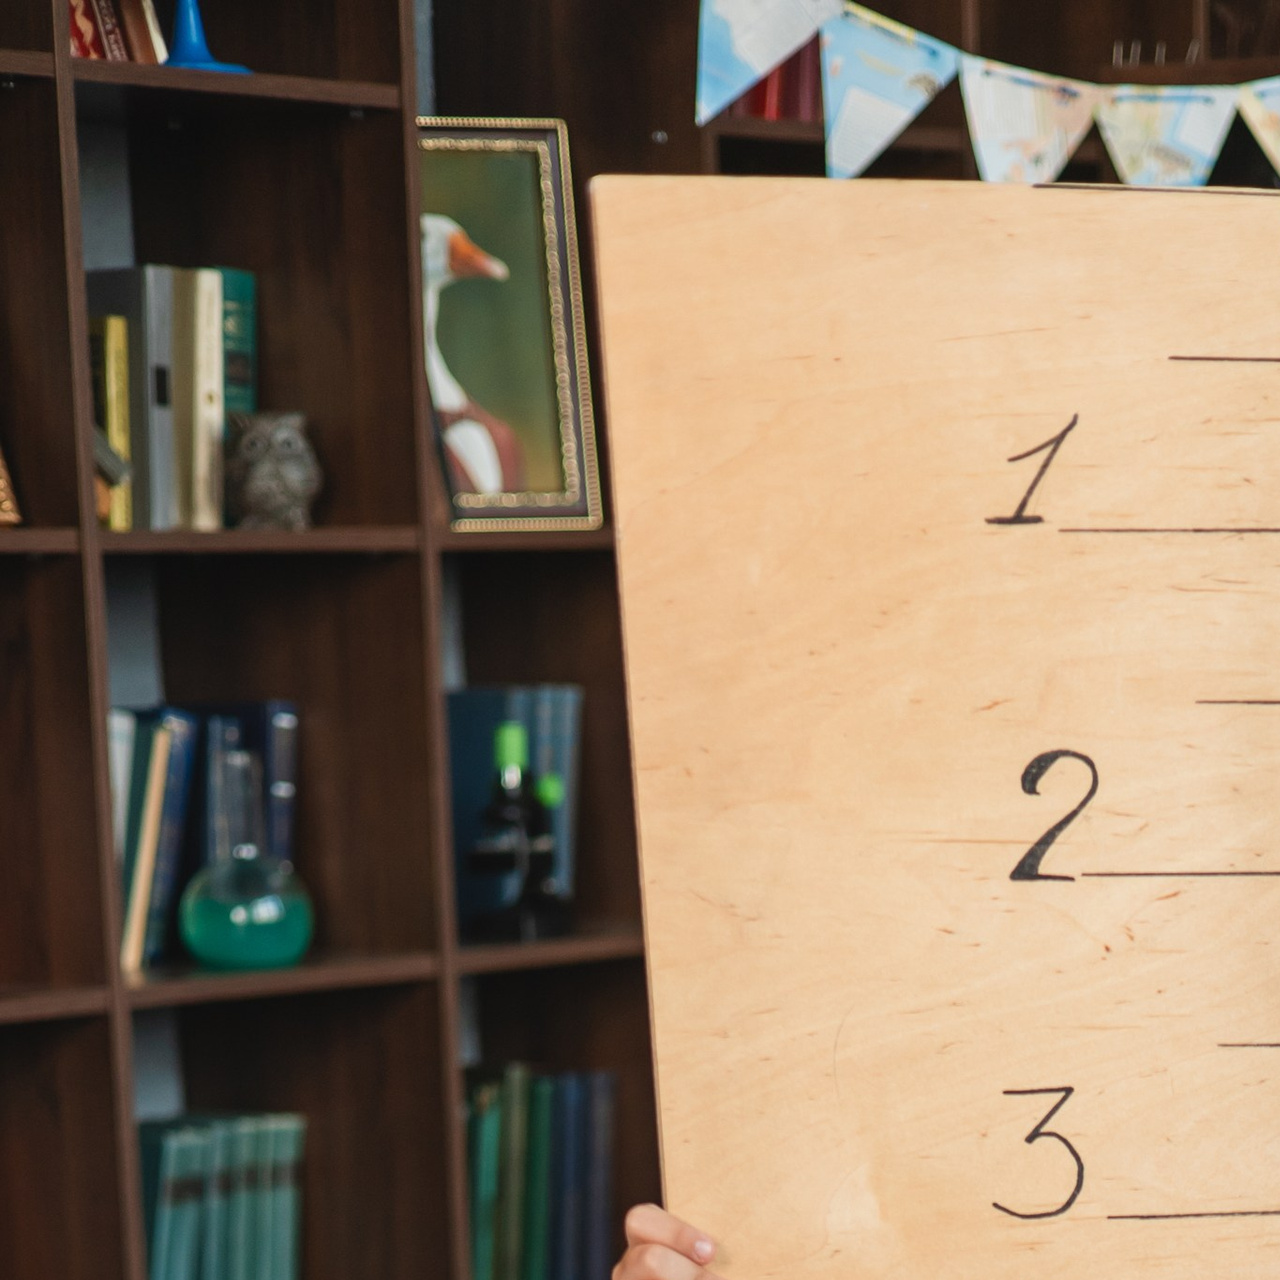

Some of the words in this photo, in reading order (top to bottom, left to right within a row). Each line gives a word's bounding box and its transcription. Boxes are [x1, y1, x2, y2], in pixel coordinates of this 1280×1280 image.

[986, 414, 1078, 525] 1
[1009, 748, 1099, 881] 2
[992, 1086, 1084, 1219] 3
